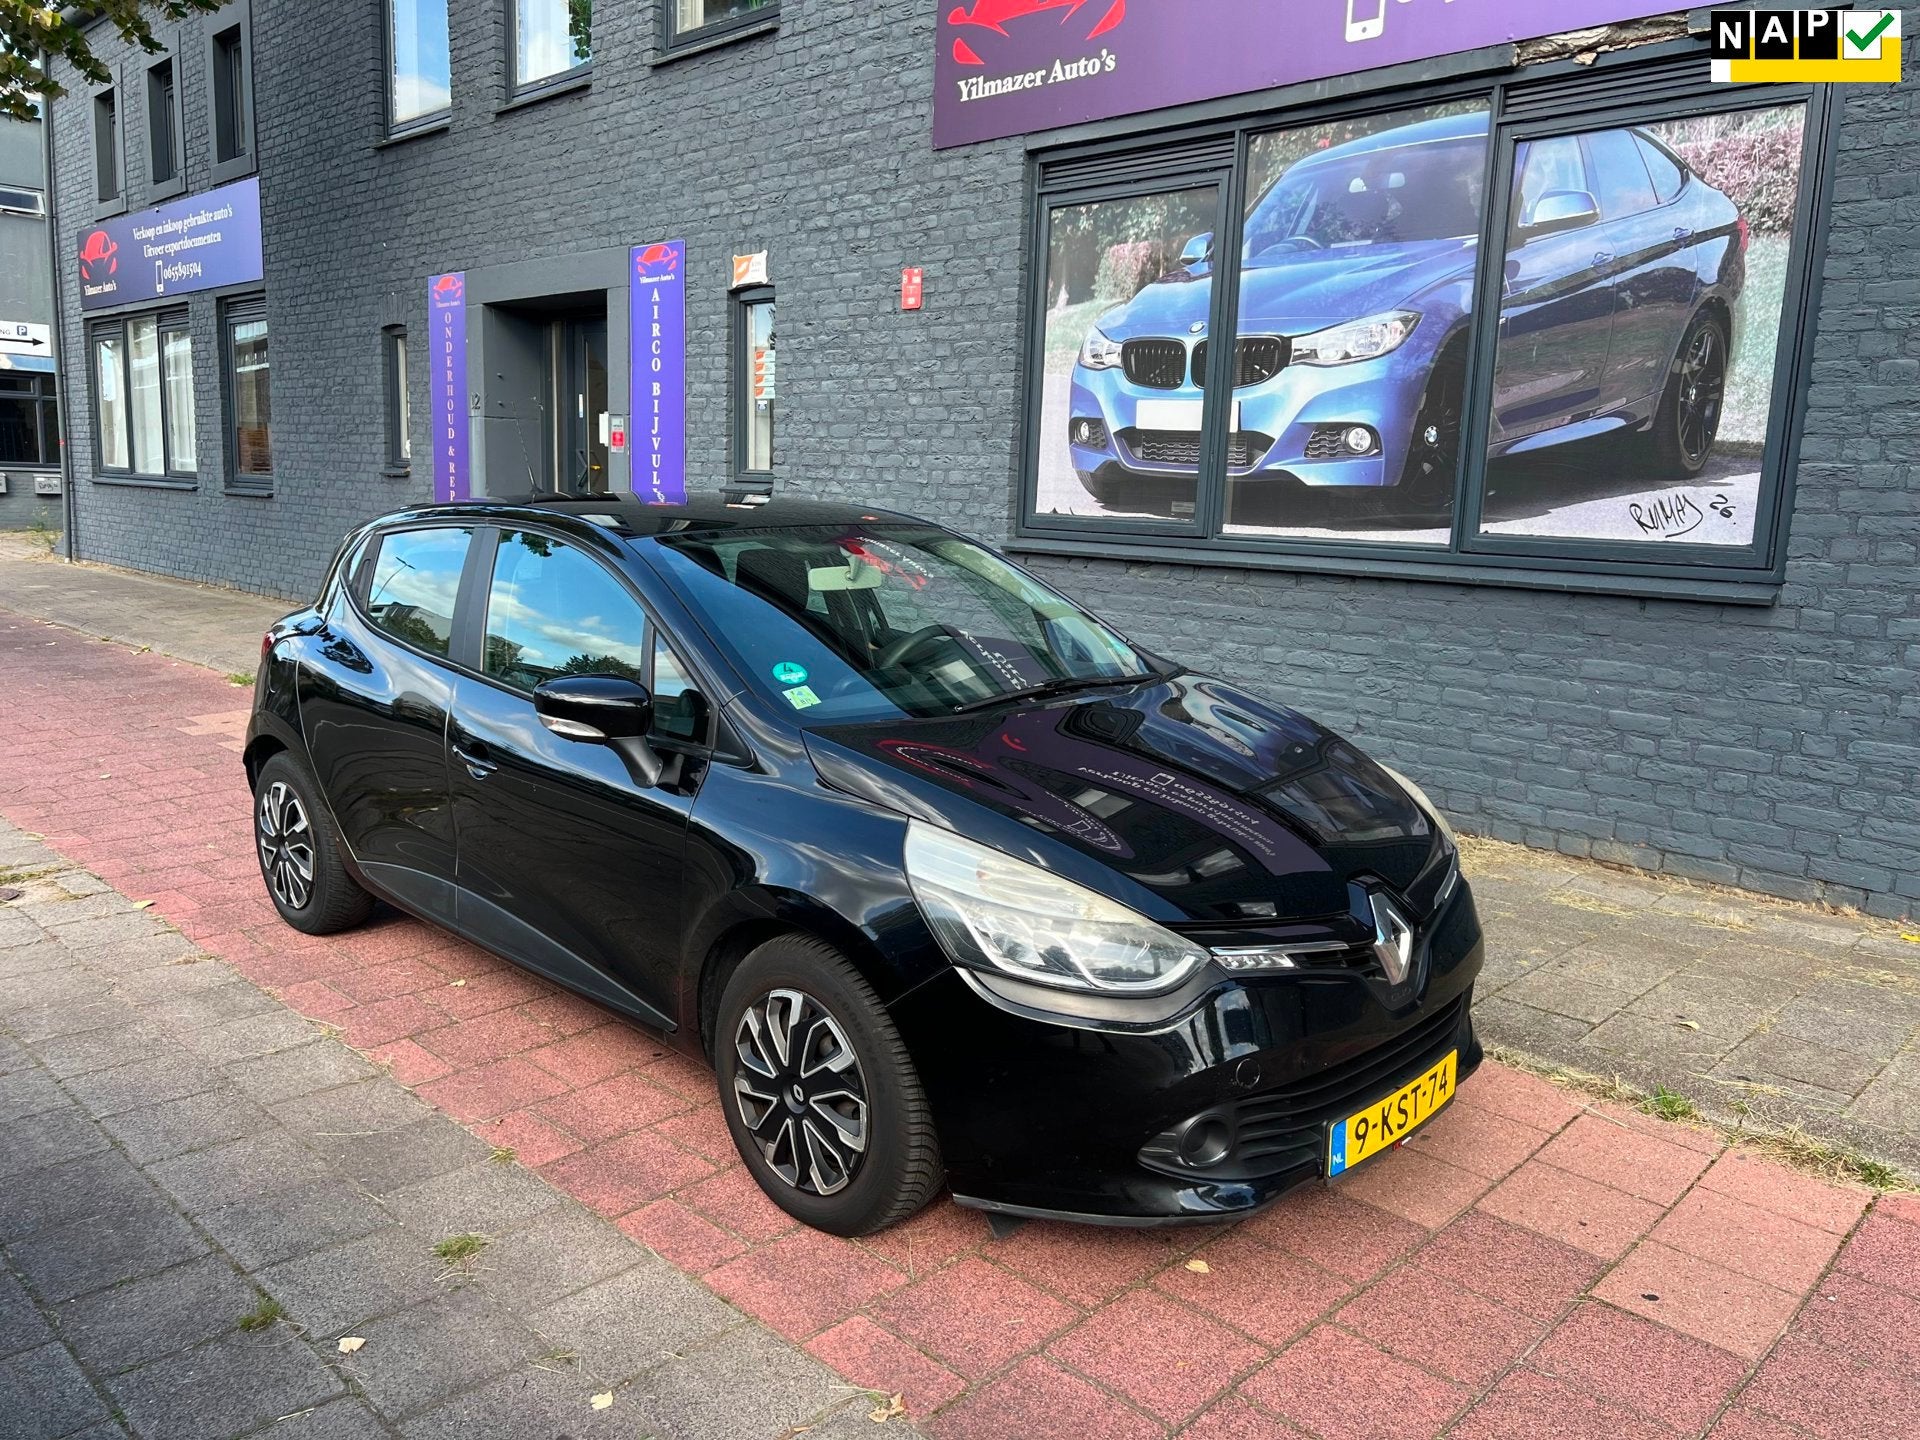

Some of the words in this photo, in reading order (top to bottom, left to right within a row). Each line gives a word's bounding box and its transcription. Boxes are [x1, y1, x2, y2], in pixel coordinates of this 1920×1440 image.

[957, 69, 1046, 102] Yilmazer
[1047, 48, 1116, 84] Auto's
[132, 226, 156, 241] Verkoop
[155, 225, 163, 236] en
[163, 219, 183, 234] inkoop
[183, 210, 213, 233] gebruikte
[213, 203, 233, 221] auto's
[143, 244, 166, 258] Uitvoer
[164, 231, 222, 256] exportdocumenten
[163, 261, 202, 281] 0655891504
[651, 287, 661, 372] AIRCO
[444, 312, 455, 439] ONDERHOUD
[448, 445, 455, 457] &
[1354, 1063, 1448, 1154] 9-KST-74
[1333, 1153, 1344, 1166] NL
